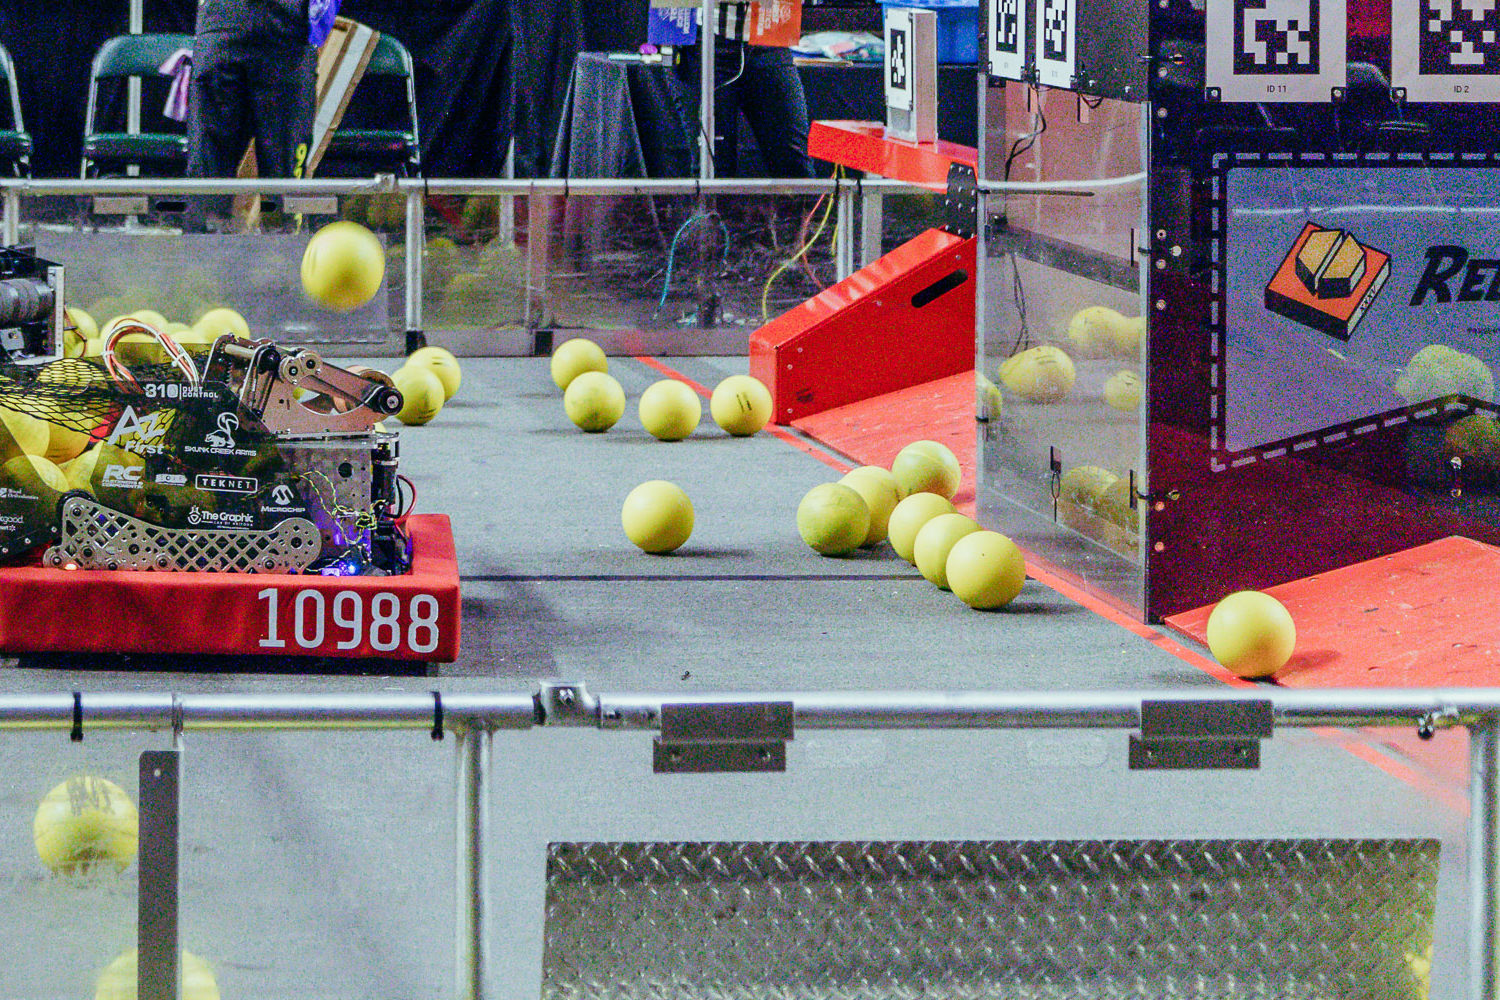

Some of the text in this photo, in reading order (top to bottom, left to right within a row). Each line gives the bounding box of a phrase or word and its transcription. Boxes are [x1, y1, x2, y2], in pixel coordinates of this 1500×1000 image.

[1266, 85, 1287, 93] ID 11
[1453, 85, 1470, 93] ID 2
[145, 383, 180, 398] 310
[182, 391, 219, 399] CONTROL
[184, 445, 257, 457] SKUNK CREEK ARMS
[103, 464, 144, 481] RC
[202, 478, 251, 489] TEKNET
[201, 510, 254, 523] The Graphic
[258, 587, 440, 654] 10988
